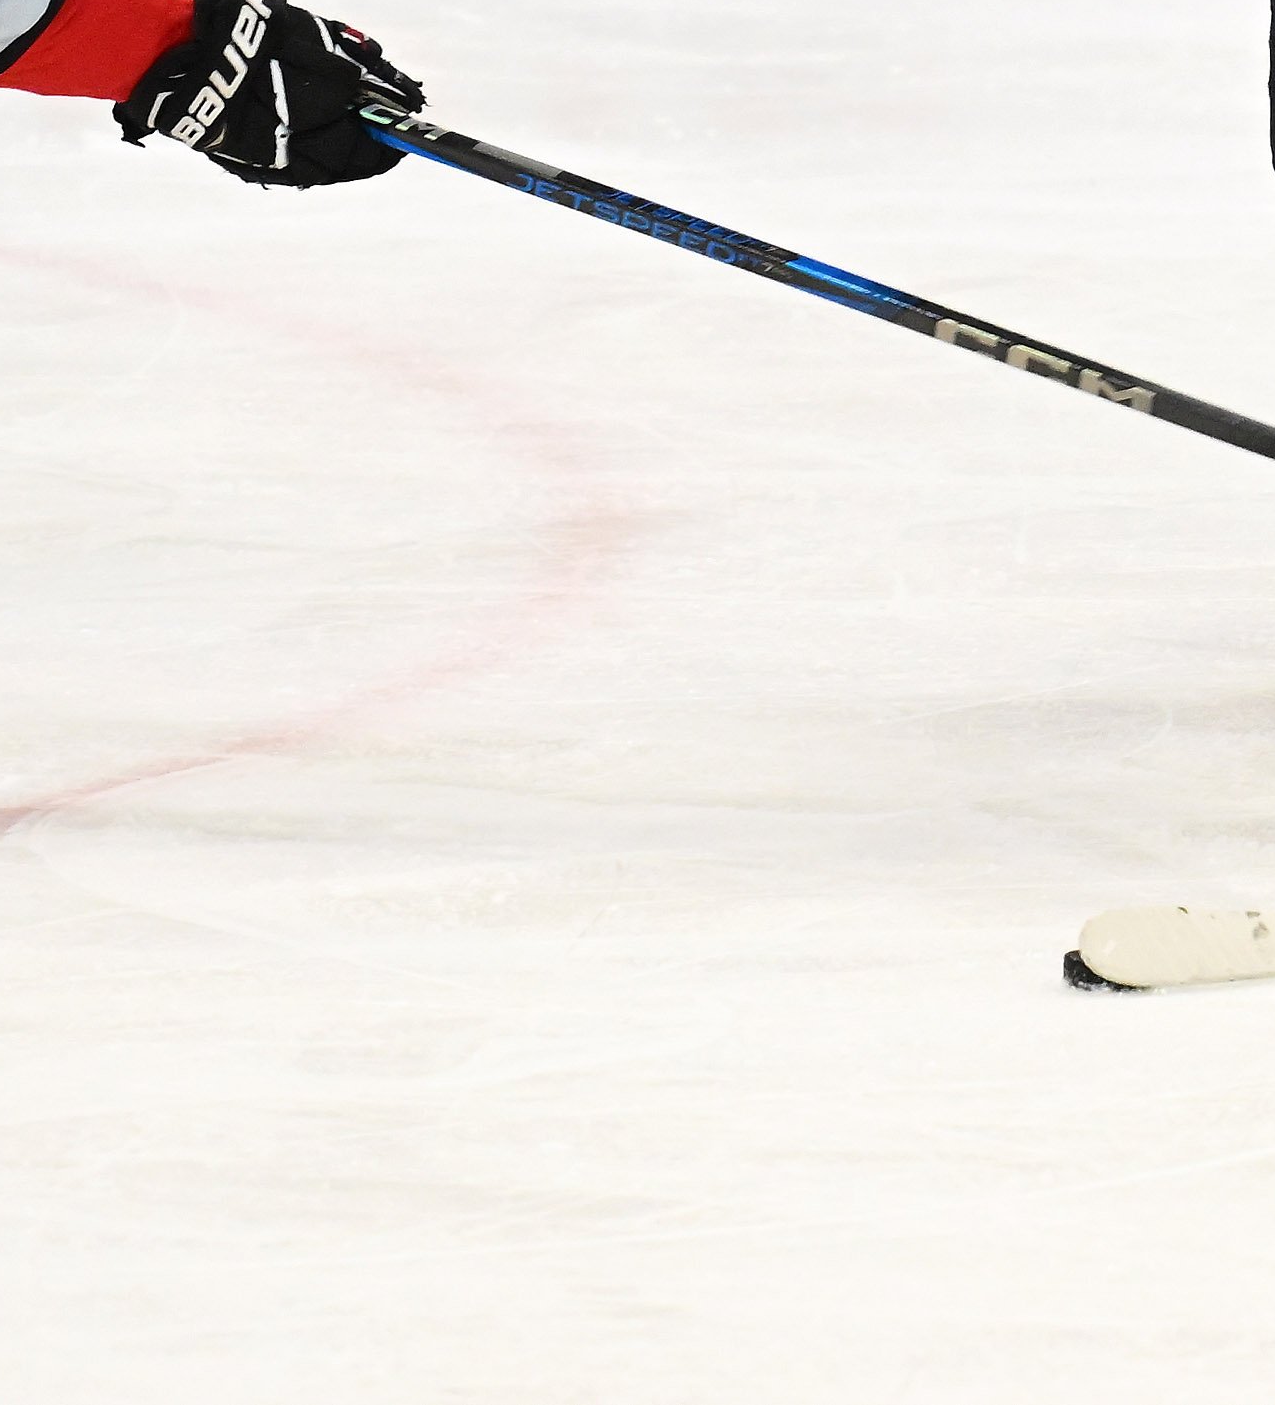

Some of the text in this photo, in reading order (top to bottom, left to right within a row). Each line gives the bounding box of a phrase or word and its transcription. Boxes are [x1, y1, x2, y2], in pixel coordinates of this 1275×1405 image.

[358, 103, 448, 141] CM
[508, 172, 737, 264] JETSPEED
[934, 317, 1157, 415] CCM
